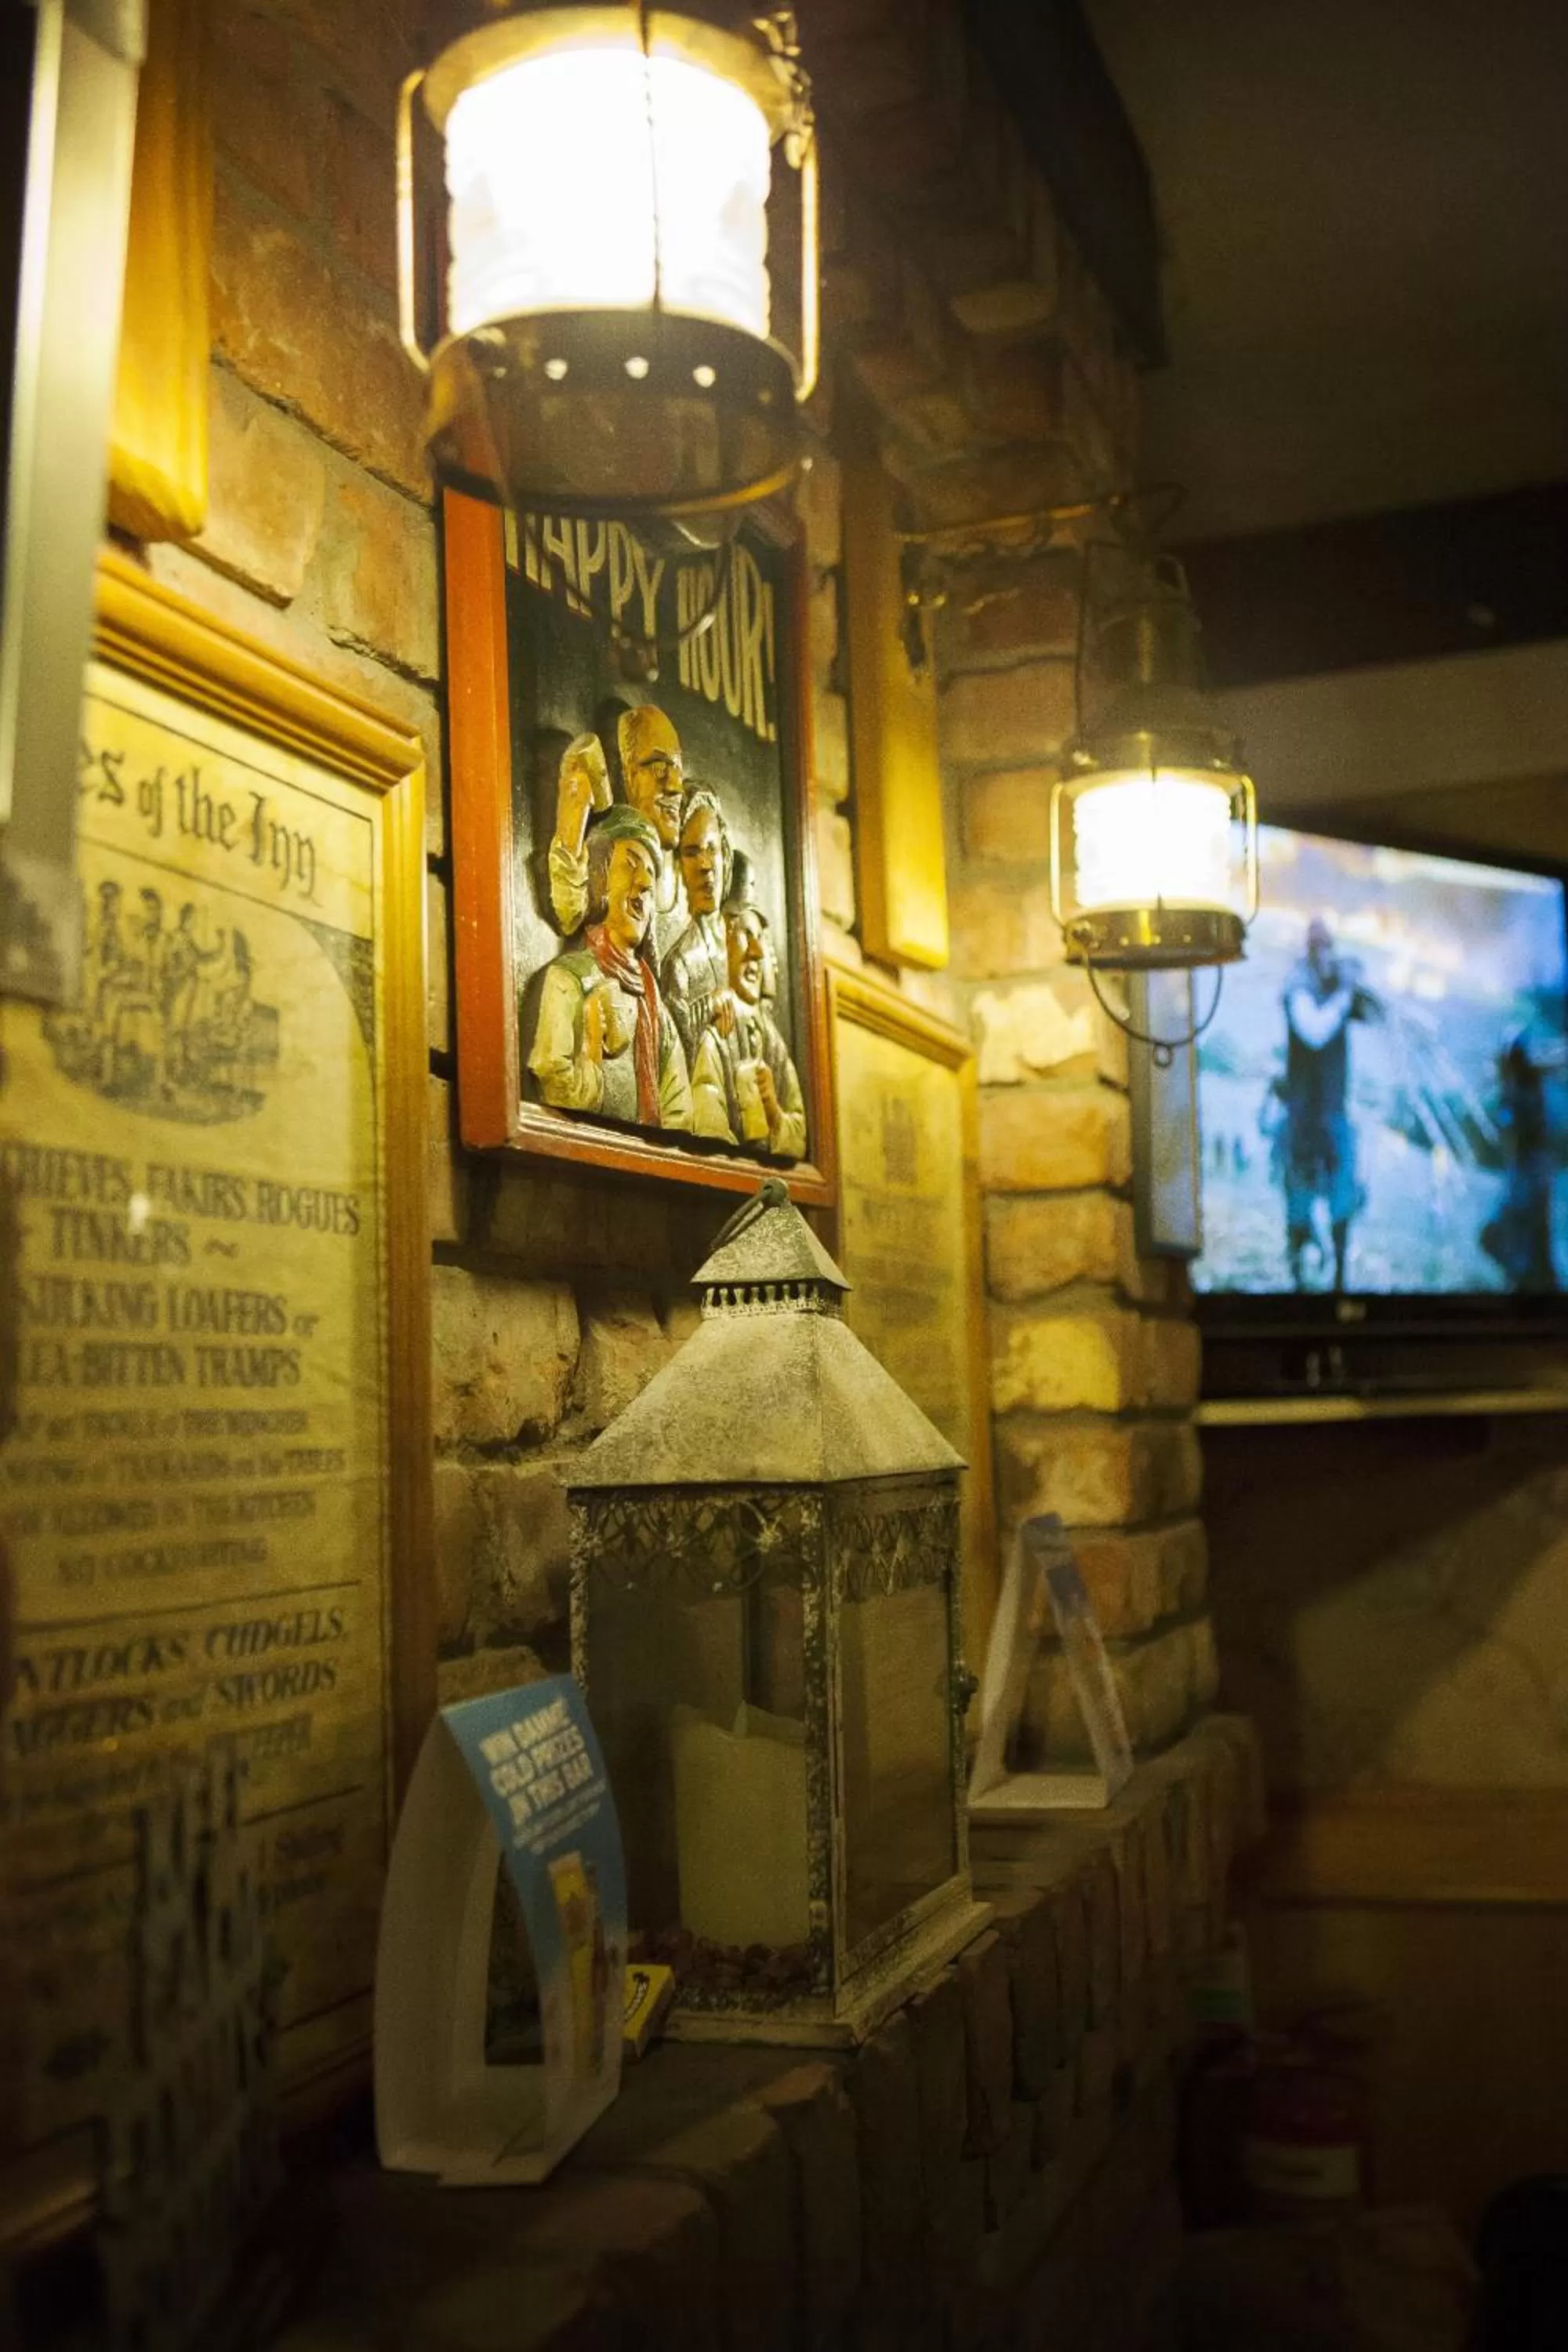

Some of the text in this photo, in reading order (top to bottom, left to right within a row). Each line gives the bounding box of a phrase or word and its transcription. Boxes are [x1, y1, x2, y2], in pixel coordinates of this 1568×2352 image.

[136, 765, 168, 840] of
[175, 764, 241, 852] the
[249, 790, 324, 908] Inn
[257, 1181, 361, 1236] ROGUES
[167, 1283, 288, 1336] LOAFERS
[194, 1345, 301, 1388] TRAMPS
[216, 1658, 338, 1708] SWORDS
